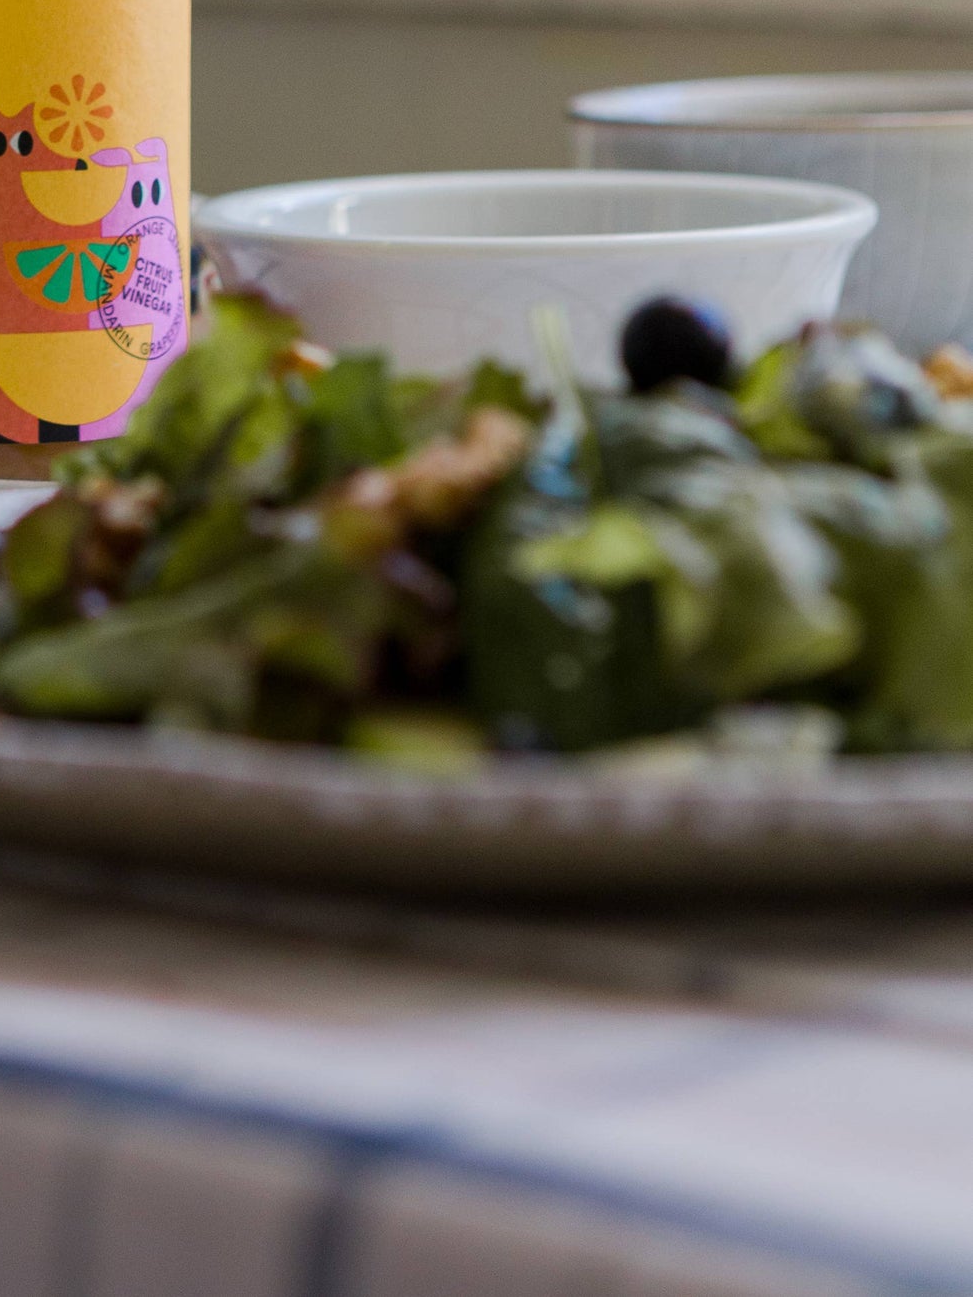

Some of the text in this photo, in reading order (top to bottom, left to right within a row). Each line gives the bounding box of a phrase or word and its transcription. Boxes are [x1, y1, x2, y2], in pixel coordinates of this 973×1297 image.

[118, 222, 165, 255] ORANGE
[135, 257, 173, 284] CITRUS
[136, 275, 168, 297] FRUIT
[100, 264, 134, 348] MANDARIN
[121, 285, 172, 317] VINEGAR
